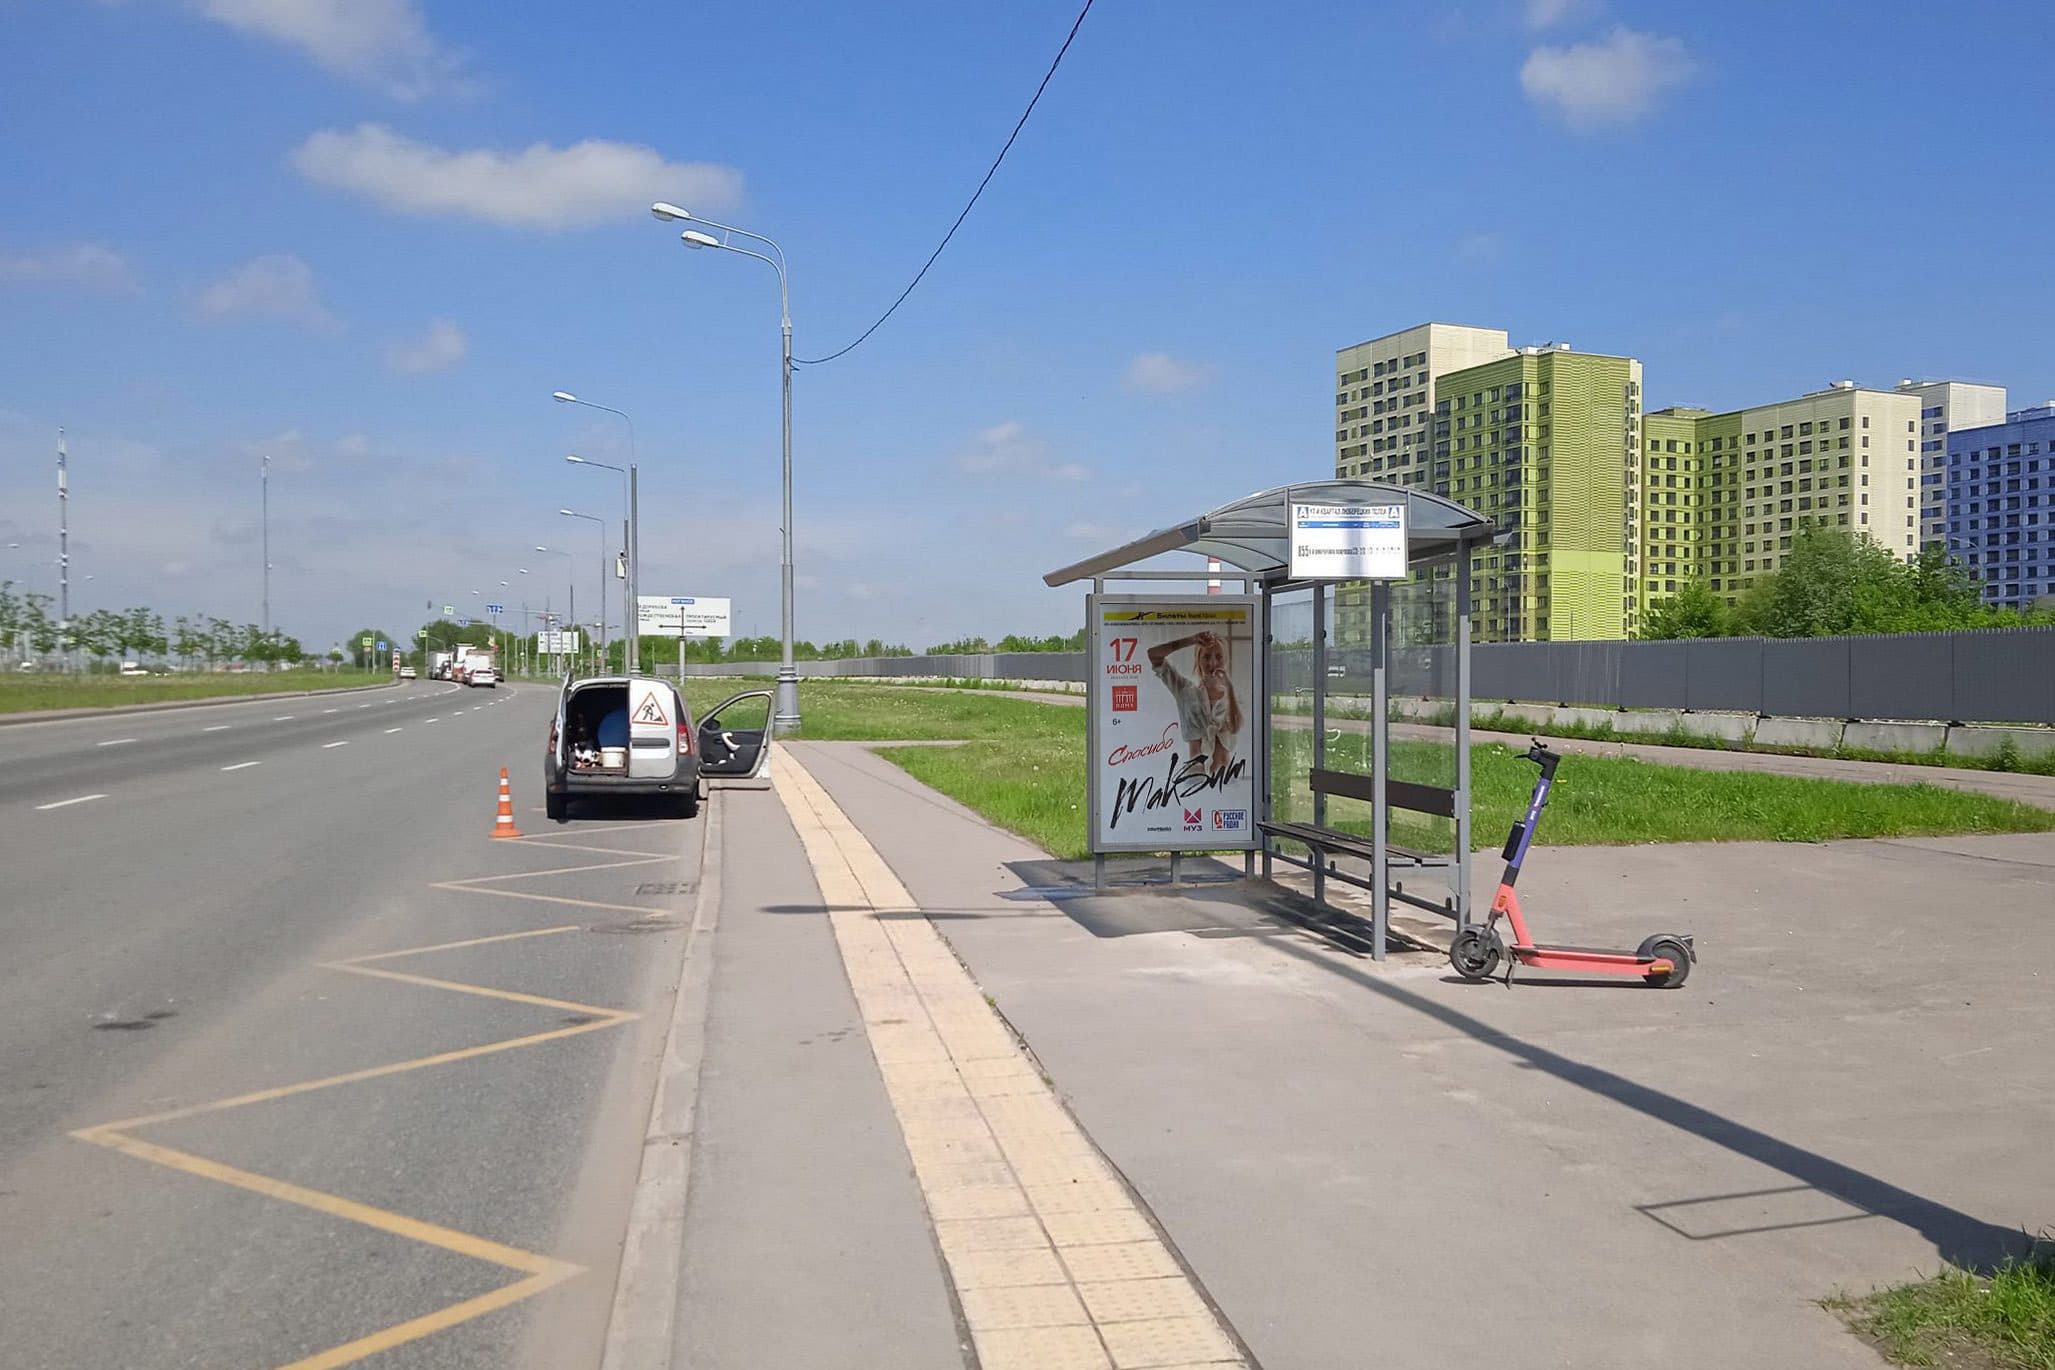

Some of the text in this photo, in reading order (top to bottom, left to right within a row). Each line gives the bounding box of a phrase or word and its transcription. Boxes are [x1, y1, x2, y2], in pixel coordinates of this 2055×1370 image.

[1109, 638, 1138, 662] 17
[1106, 664, 1142, 674] ИЮНЯ
[1112, 718, 1122, 726] 6+
[1108, 722, 1178, 766] Спасибо
